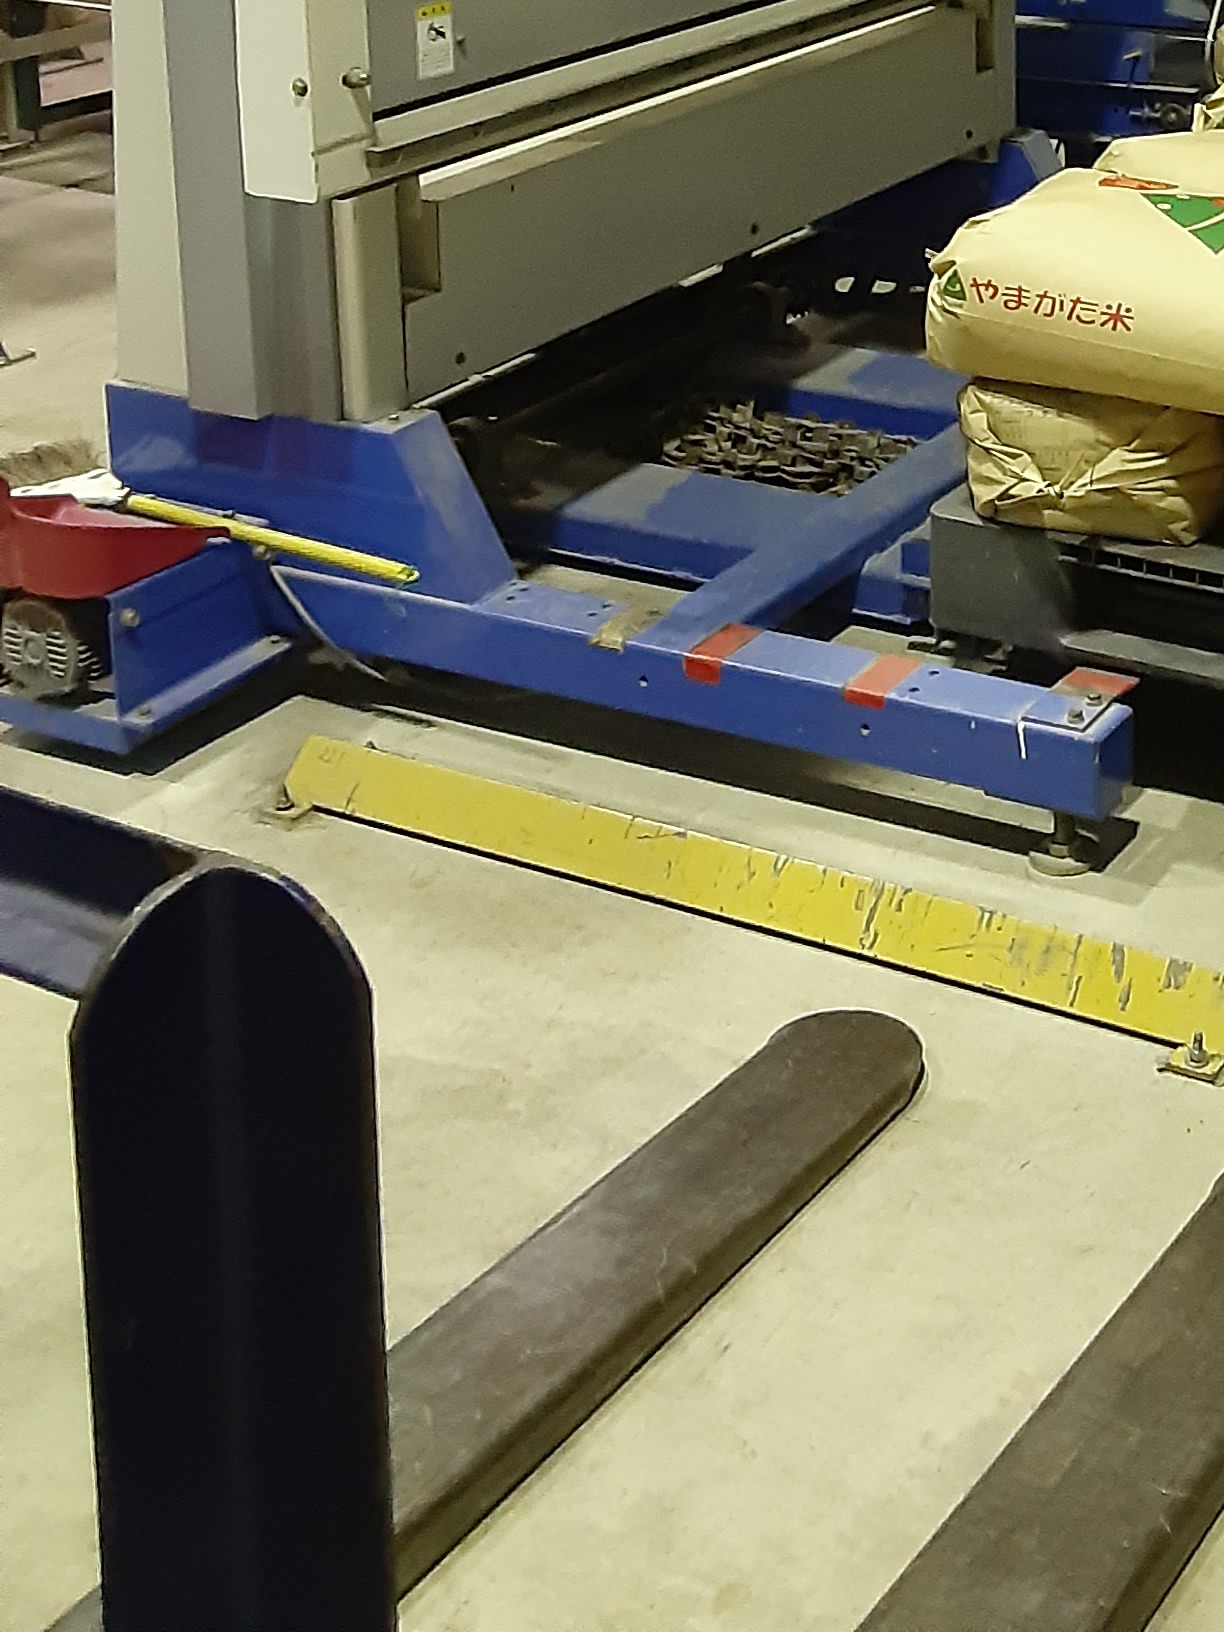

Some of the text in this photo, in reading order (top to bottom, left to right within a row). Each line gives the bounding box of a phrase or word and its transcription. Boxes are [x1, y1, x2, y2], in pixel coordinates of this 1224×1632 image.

[970, 277, 1135, 332] やまがた米
